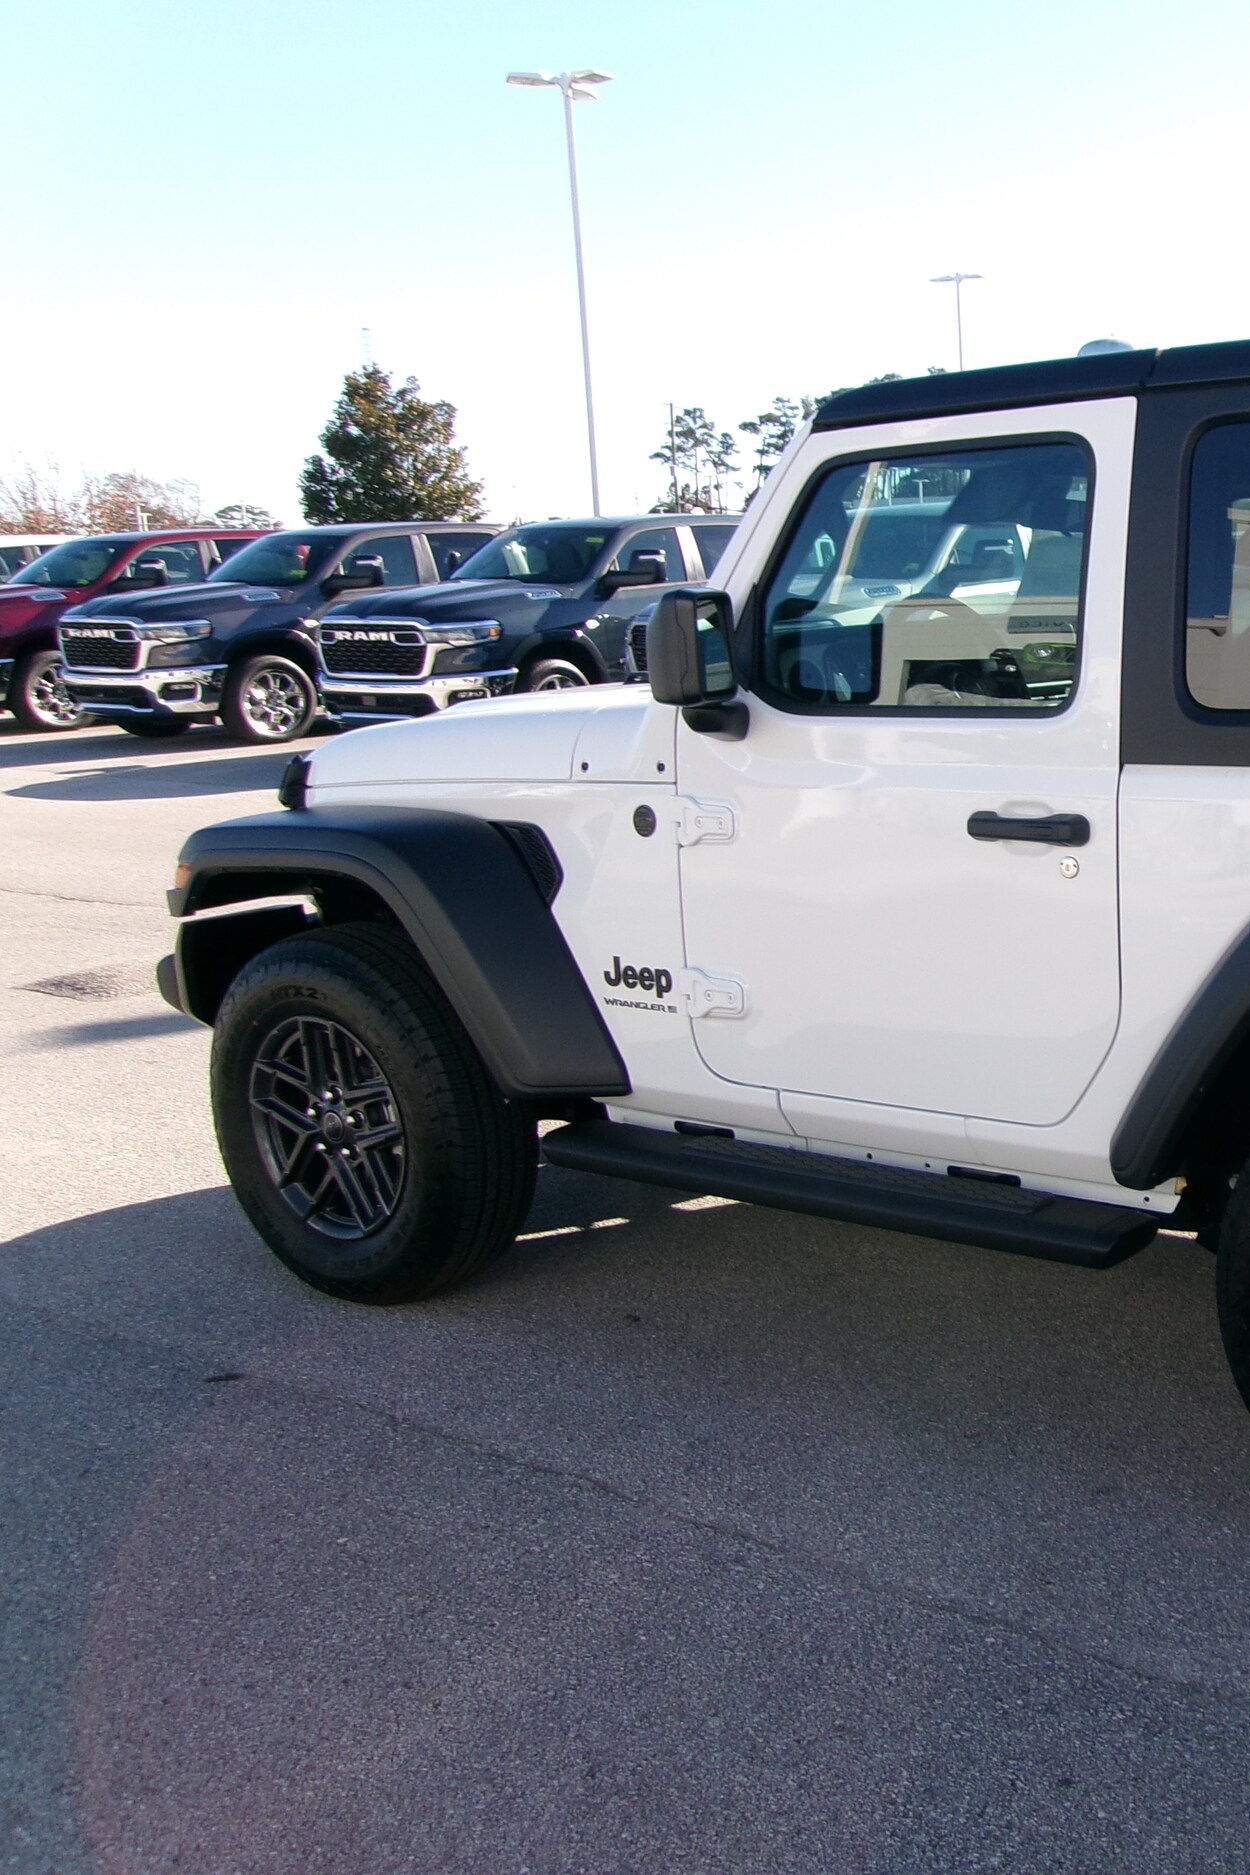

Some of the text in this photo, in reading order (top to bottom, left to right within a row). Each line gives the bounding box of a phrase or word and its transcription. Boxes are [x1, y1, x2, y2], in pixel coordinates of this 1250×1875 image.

[68, 627, 109, 639] RAM
[334, 629, 391, 642] RAM
[603, 955, 673, 999] Jeep
[603, 997, 666, 1013] WRANGLER
